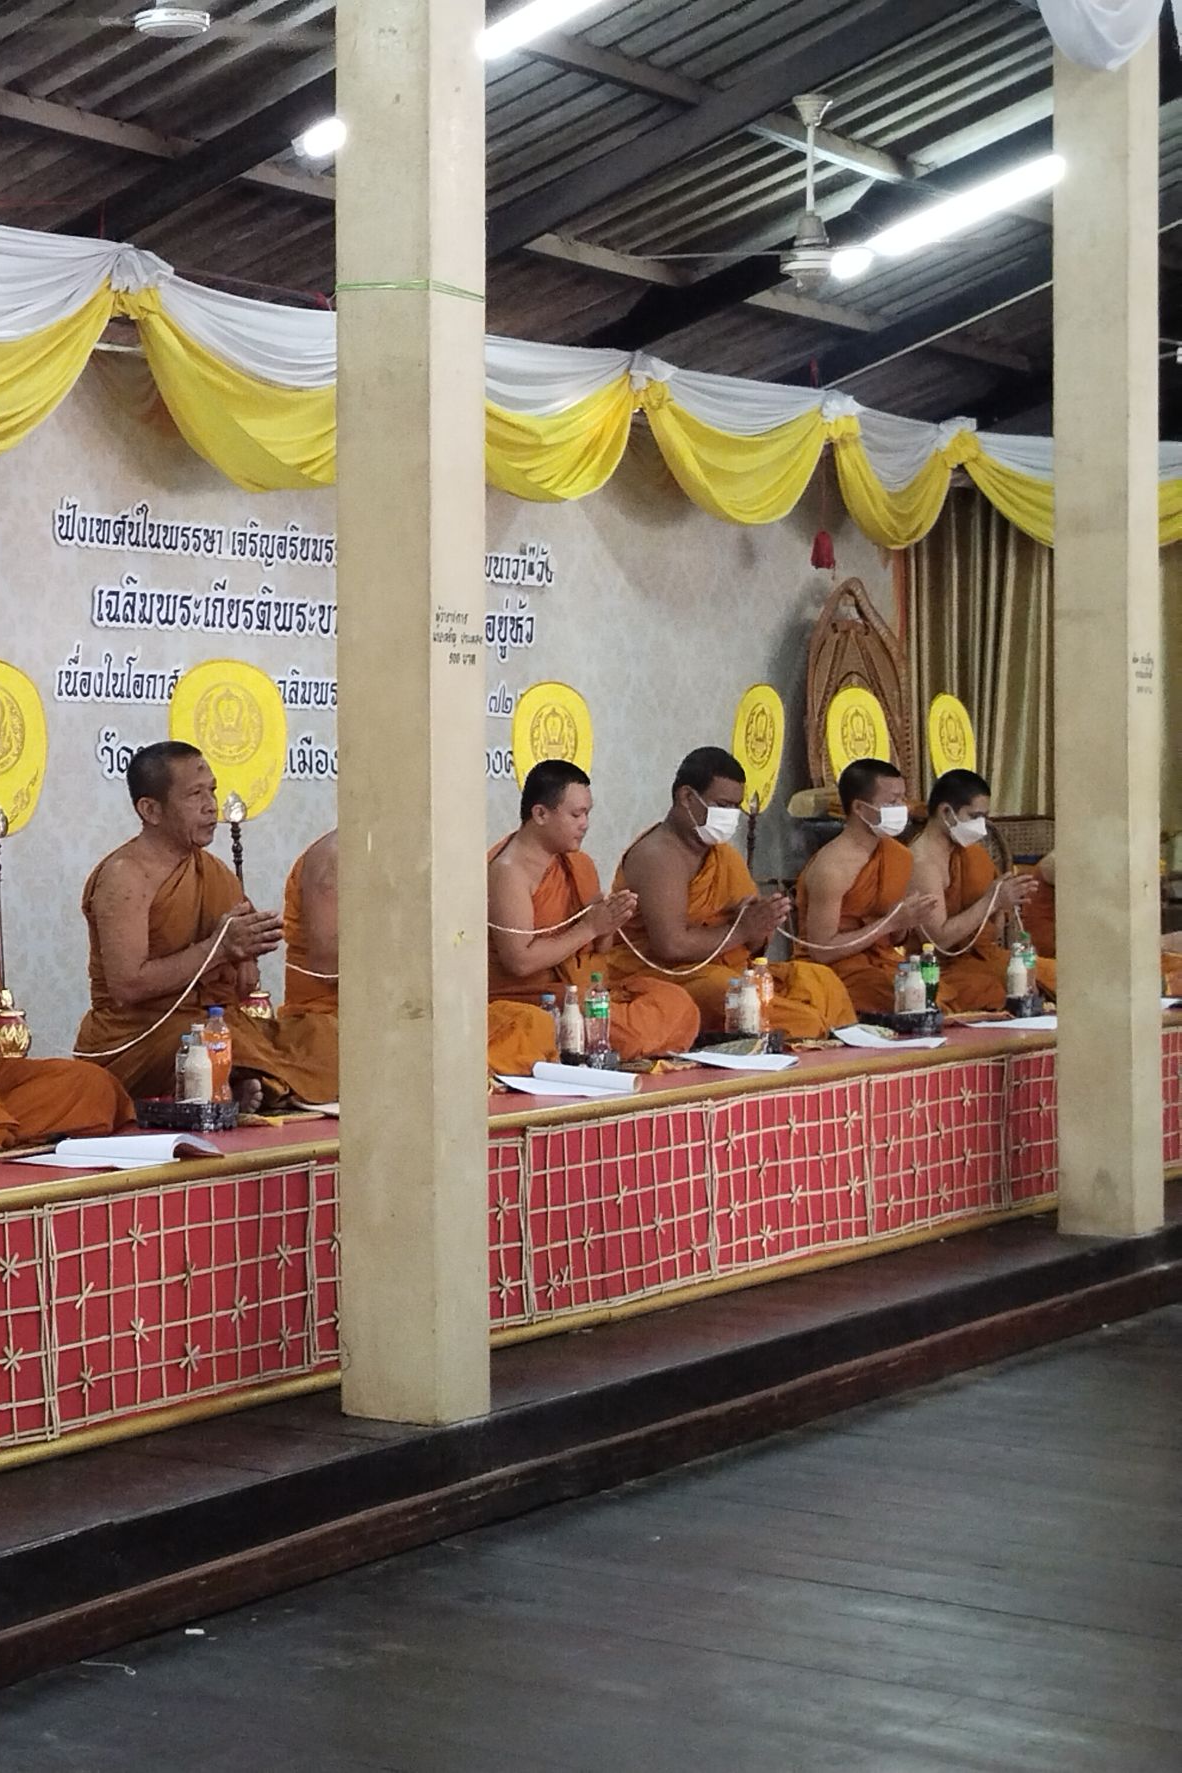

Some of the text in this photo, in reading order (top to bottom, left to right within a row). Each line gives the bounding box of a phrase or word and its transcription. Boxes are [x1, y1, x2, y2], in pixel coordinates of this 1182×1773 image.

[231, 520, 338, 567] เจริญอริยมร
[100, 731, 145, 774] วัด
[284, 735, 338, 775] เมือง
